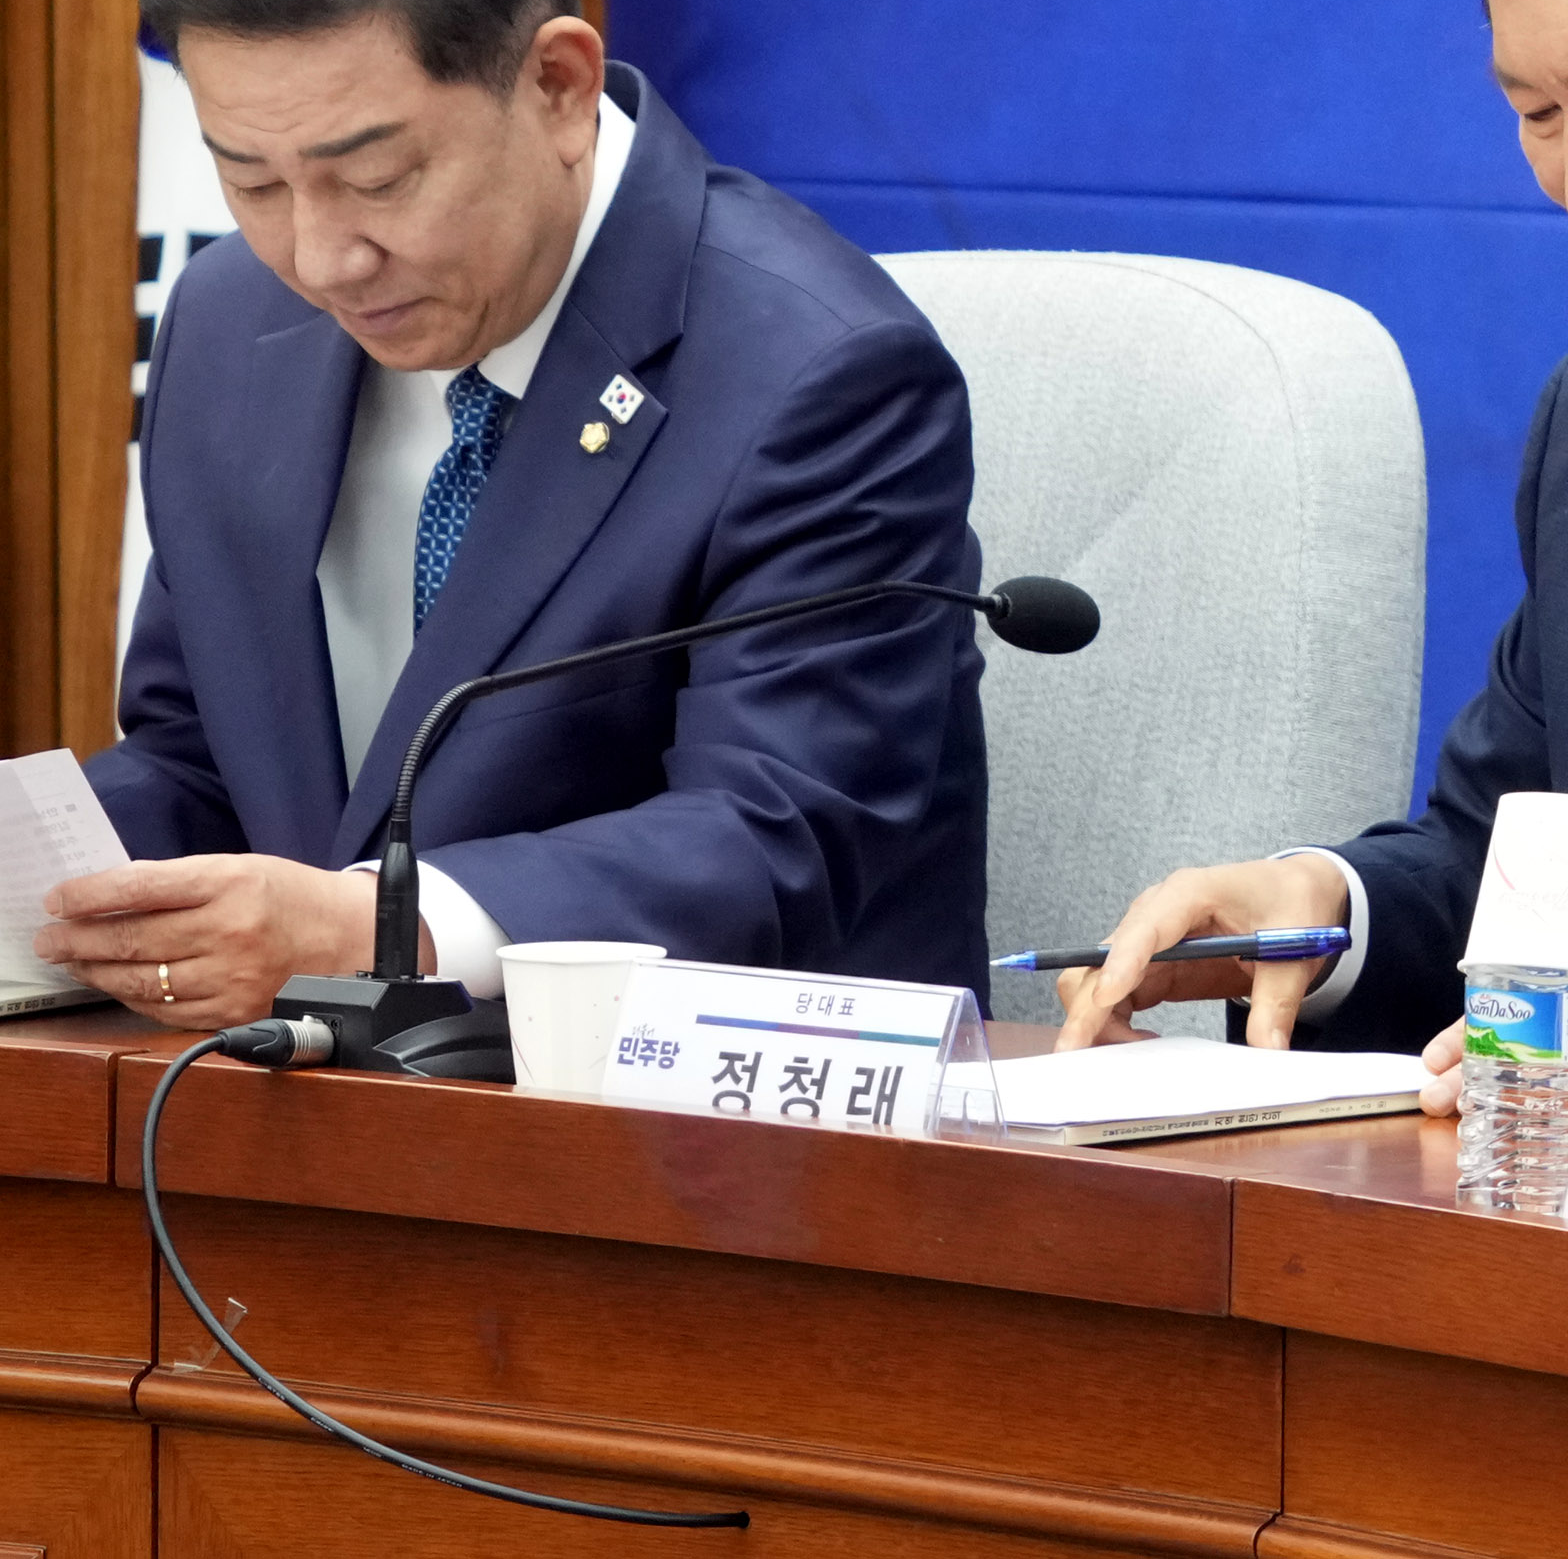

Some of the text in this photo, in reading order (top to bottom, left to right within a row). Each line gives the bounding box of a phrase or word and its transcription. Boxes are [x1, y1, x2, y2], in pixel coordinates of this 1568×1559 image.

[795, 993, 855, 1016] 당대표
[1467, 996, 1532, 1020] SamDaSoo
[617, 1037, 681, 1070] 민주당
[710, 1050, 904, 1127] 정청래
